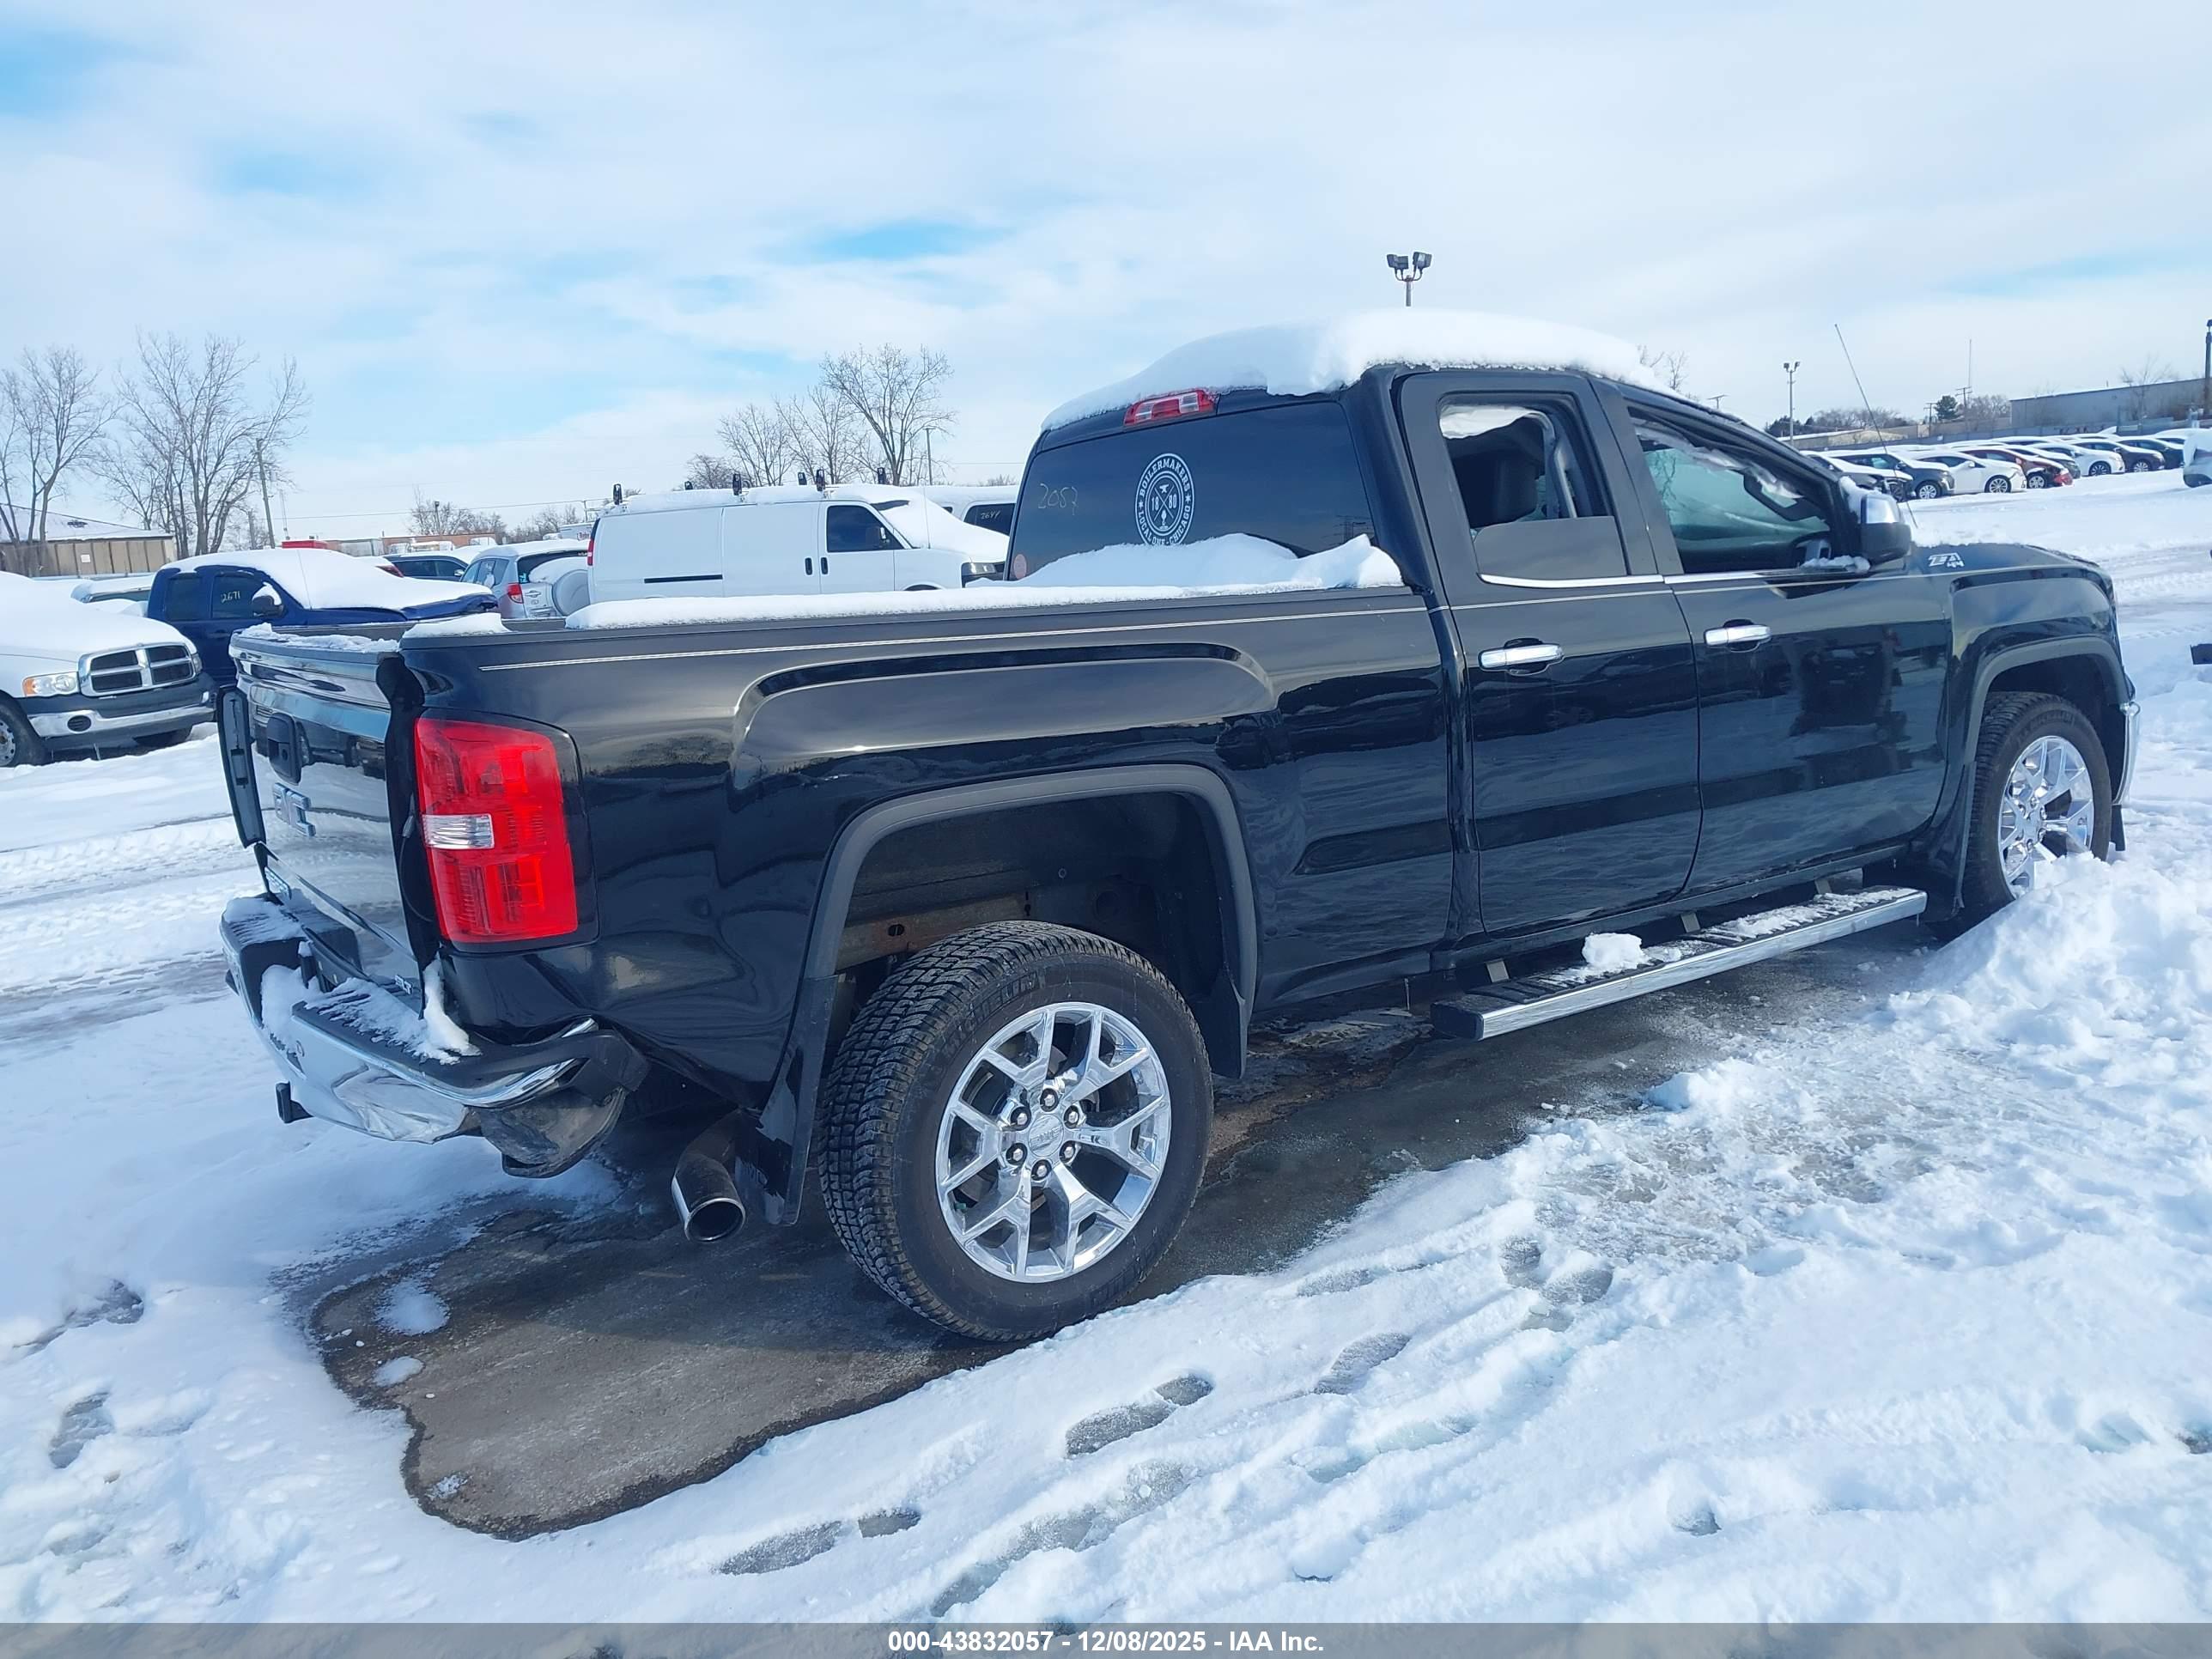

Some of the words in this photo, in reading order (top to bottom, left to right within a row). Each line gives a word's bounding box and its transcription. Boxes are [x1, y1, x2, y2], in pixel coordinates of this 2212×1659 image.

[1139, 458, 1191, 498] BOILERMAKERS
[1152, 496, 1159, 511] 18
[1169, 494, 1177, 509] 80
[1138, 509, 1152, 542] LOCAL
[1169, 505, 1191, 545] CHICAGO
[221, 590, 240, 604] 2671
